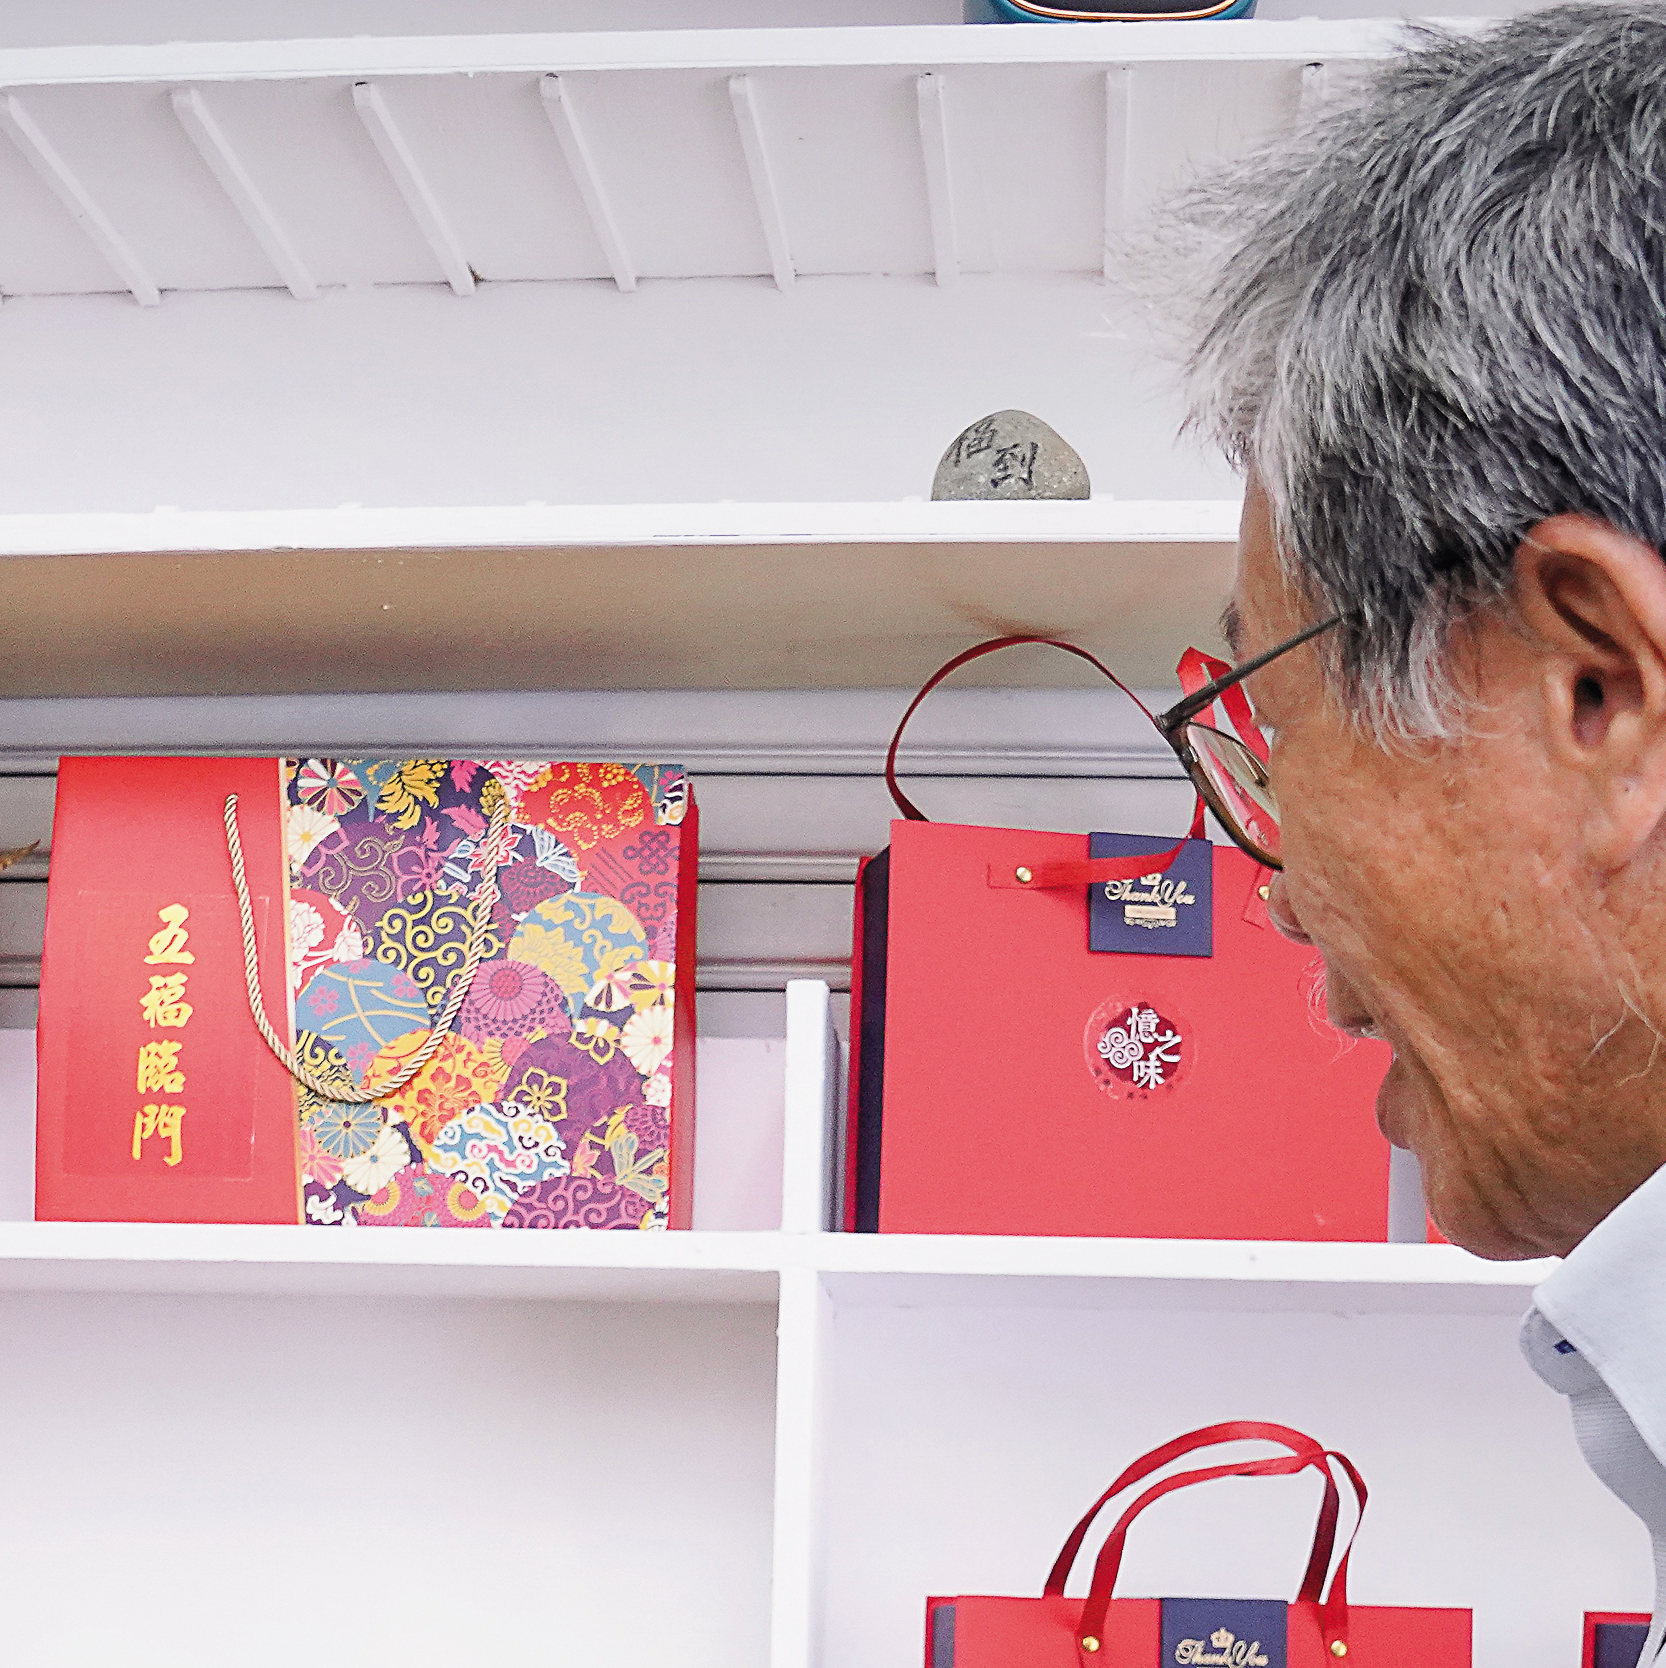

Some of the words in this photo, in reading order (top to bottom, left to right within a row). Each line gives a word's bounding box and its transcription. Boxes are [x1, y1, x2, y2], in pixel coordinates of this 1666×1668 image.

[1104, 878, 1162, 903] Thank
[1158, 878, 1196, 907] You
[131, 902, 196, 1167] 五福臨門
[1175, 1638, 1233, 1665] Thank
